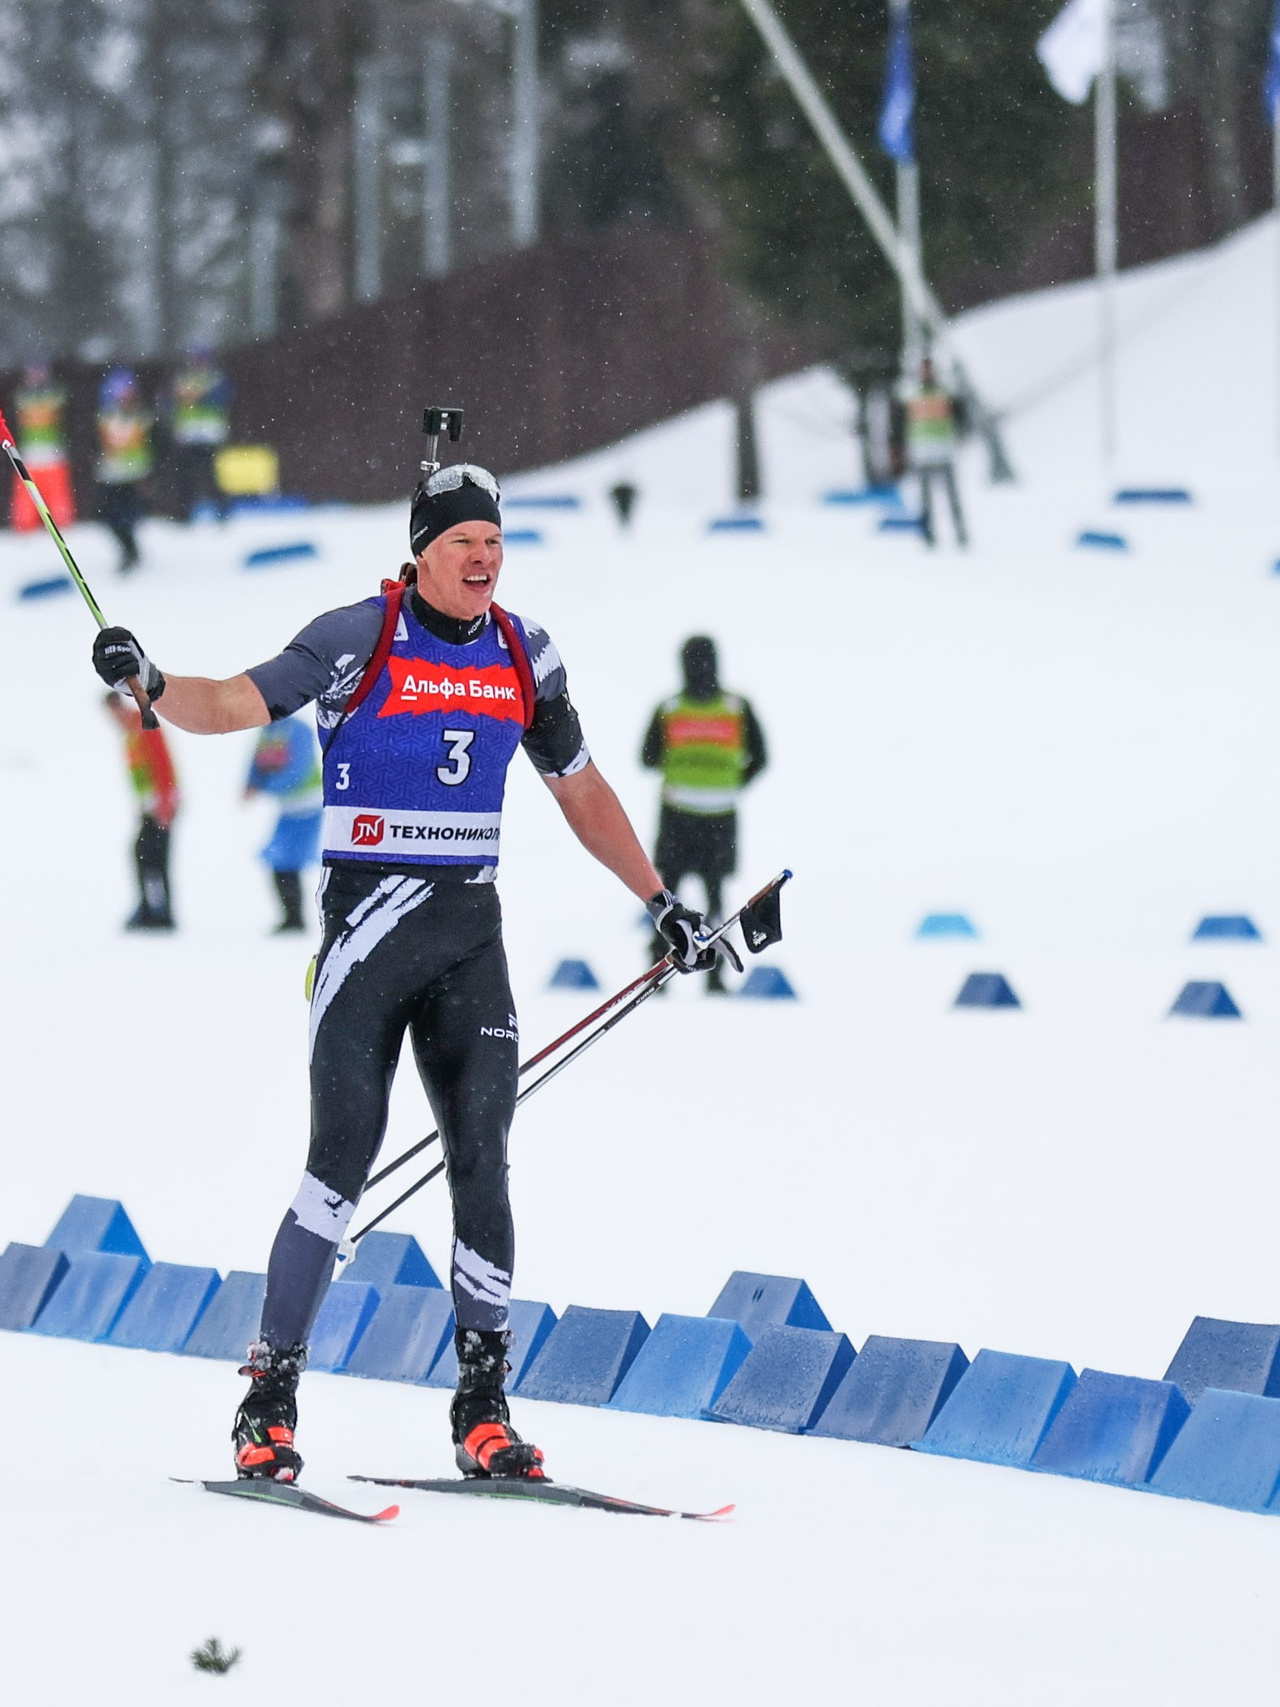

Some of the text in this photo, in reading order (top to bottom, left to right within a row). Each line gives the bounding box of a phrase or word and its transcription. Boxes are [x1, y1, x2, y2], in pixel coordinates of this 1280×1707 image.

[400, 674, 517, 701] Альфа Банк
[437, 729, 475, 786] 3
[335, 763, 351, 791] 3
